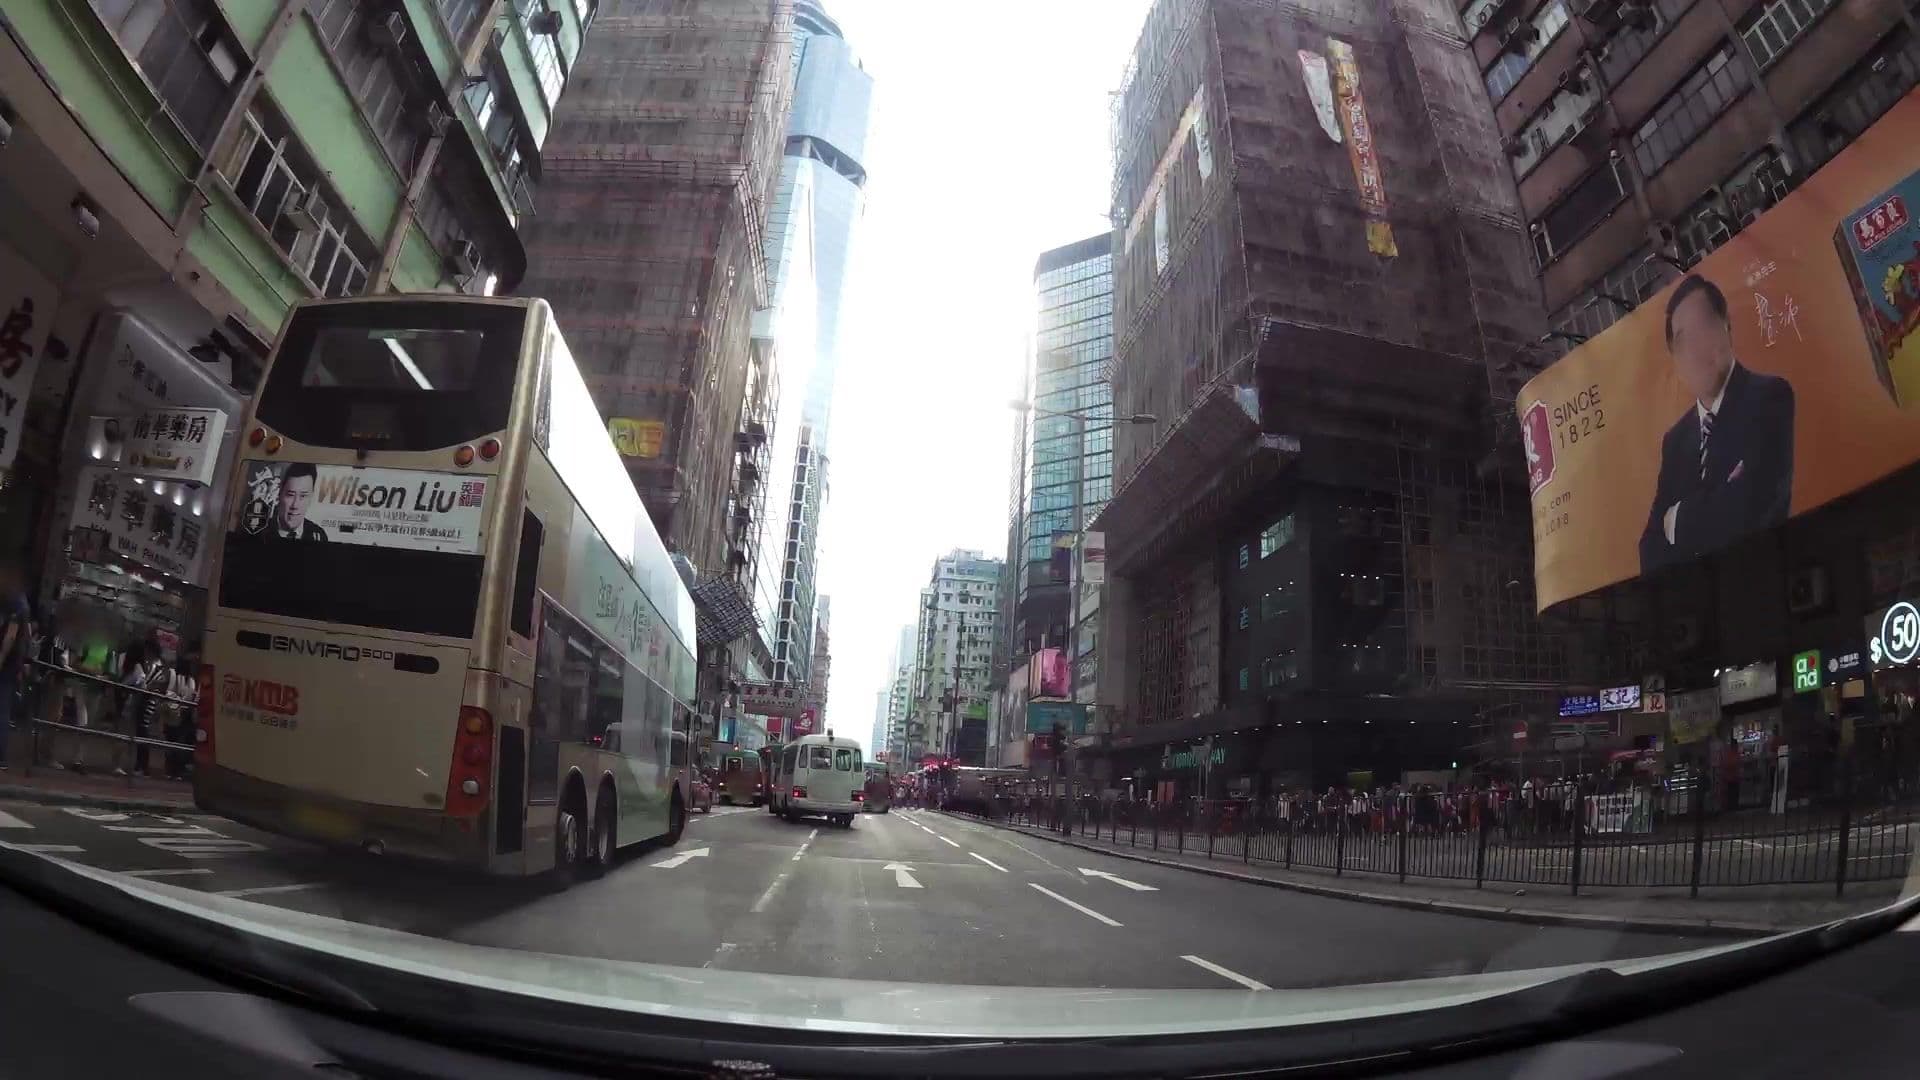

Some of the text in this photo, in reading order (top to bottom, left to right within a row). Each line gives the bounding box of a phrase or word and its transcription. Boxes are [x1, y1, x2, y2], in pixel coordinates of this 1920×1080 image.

[1553, 383, 1602, 428] SINCE
[1558, 408, 1606, 450] 1822
[317, 475, 407, 509] Wilson
[414, 480, 458, 514] Liu
[1891, 611, 1918, 652] 50
